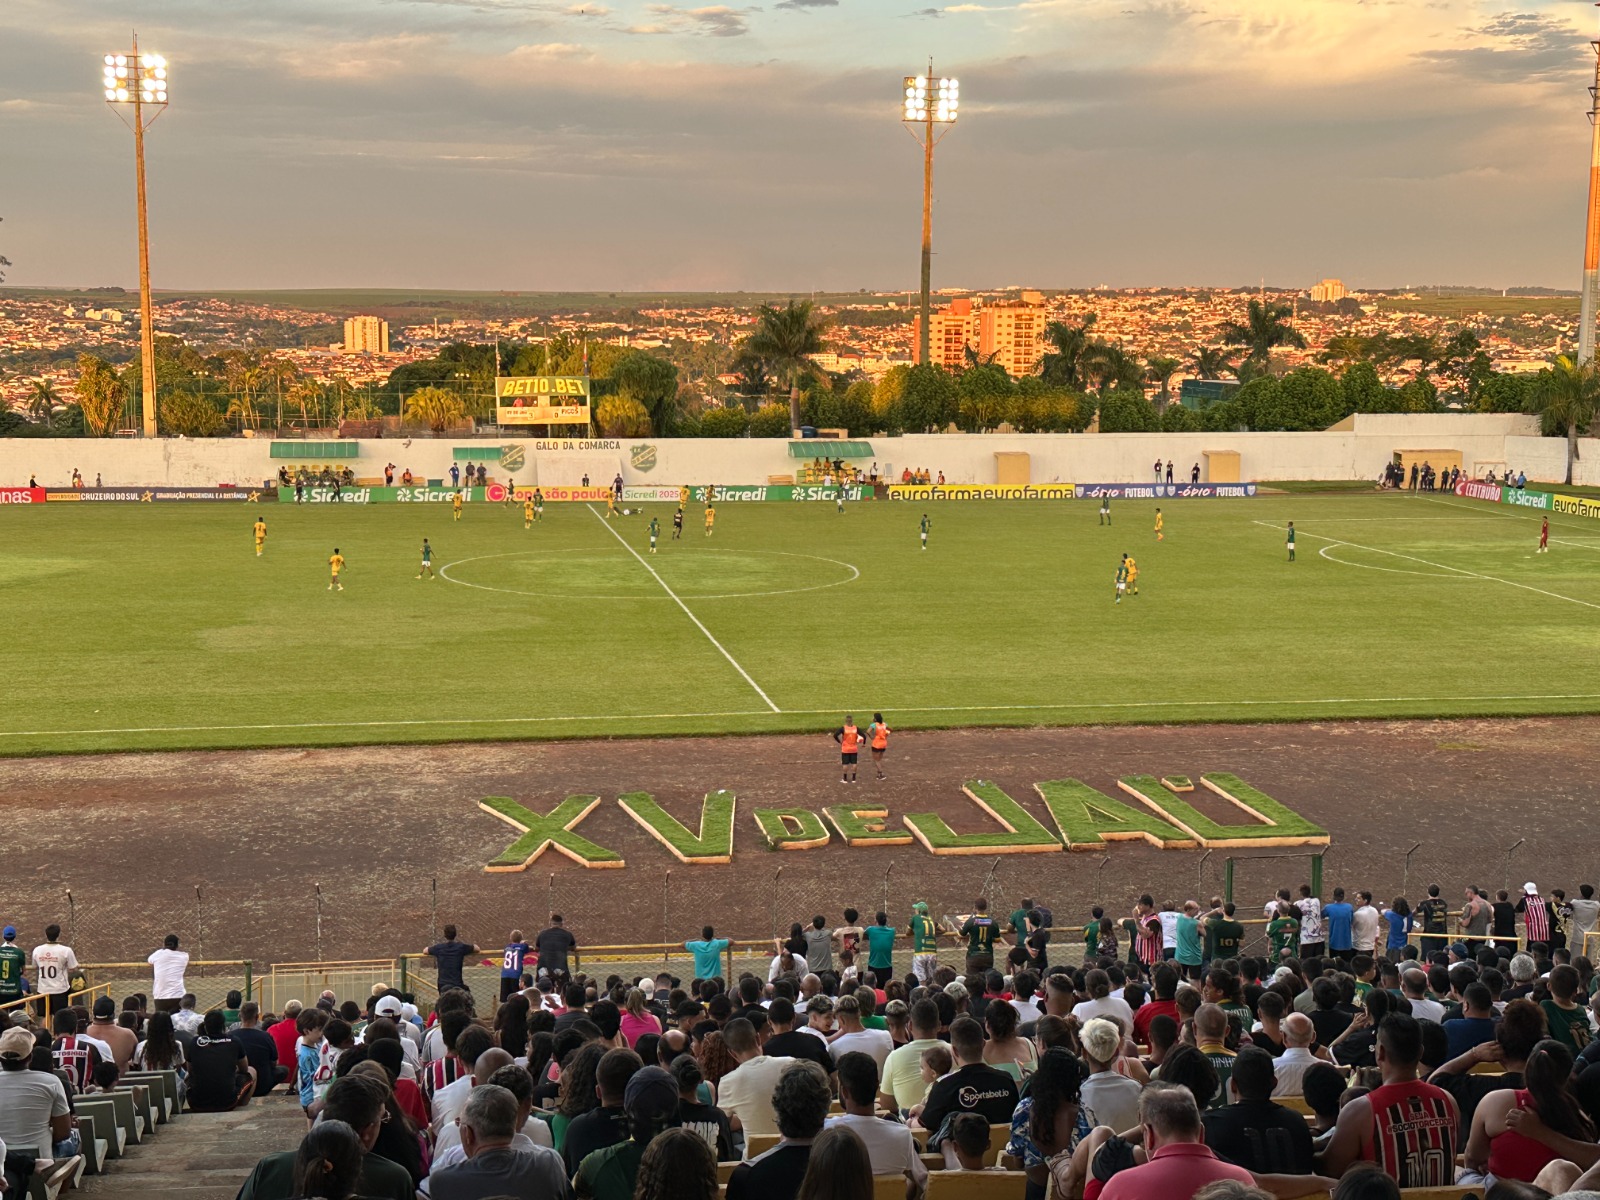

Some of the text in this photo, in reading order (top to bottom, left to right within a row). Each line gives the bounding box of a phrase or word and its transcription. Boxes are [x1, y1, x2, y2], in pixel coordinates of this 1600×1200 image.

[535, 441, 621, 450] GALO DA COMARCA
[80, 492, 115, 501] CRUZEIRO
[116, 492, 125, 501] DO
[126, 492, 139, 501] SUL
[545, 488, 569, 500] são
[624, 489, 679, 499] Sicredi 2025
[711, 487, 767, 502] Sicredi
[890, 485, 1074, 500] eurofarma eurofarma
[1465, 483, 1501, 502] CENTAURO
[1515, 488, 1548, 509] Sicredi
[477, 790, 737, 873] XV
[753, 803, 914, 851] DE
[1219, 937, 1234, 947] 10
[1283, 933, 1293, 946] 7
[503, 949, 519, 971] 81
[1, 960, 10, 979] 9
[40, 965, 57, 979] 10
[963, 1088, 1010, 1103] Sportabet.io
[1405, 1149, 1445, 1188] 10
